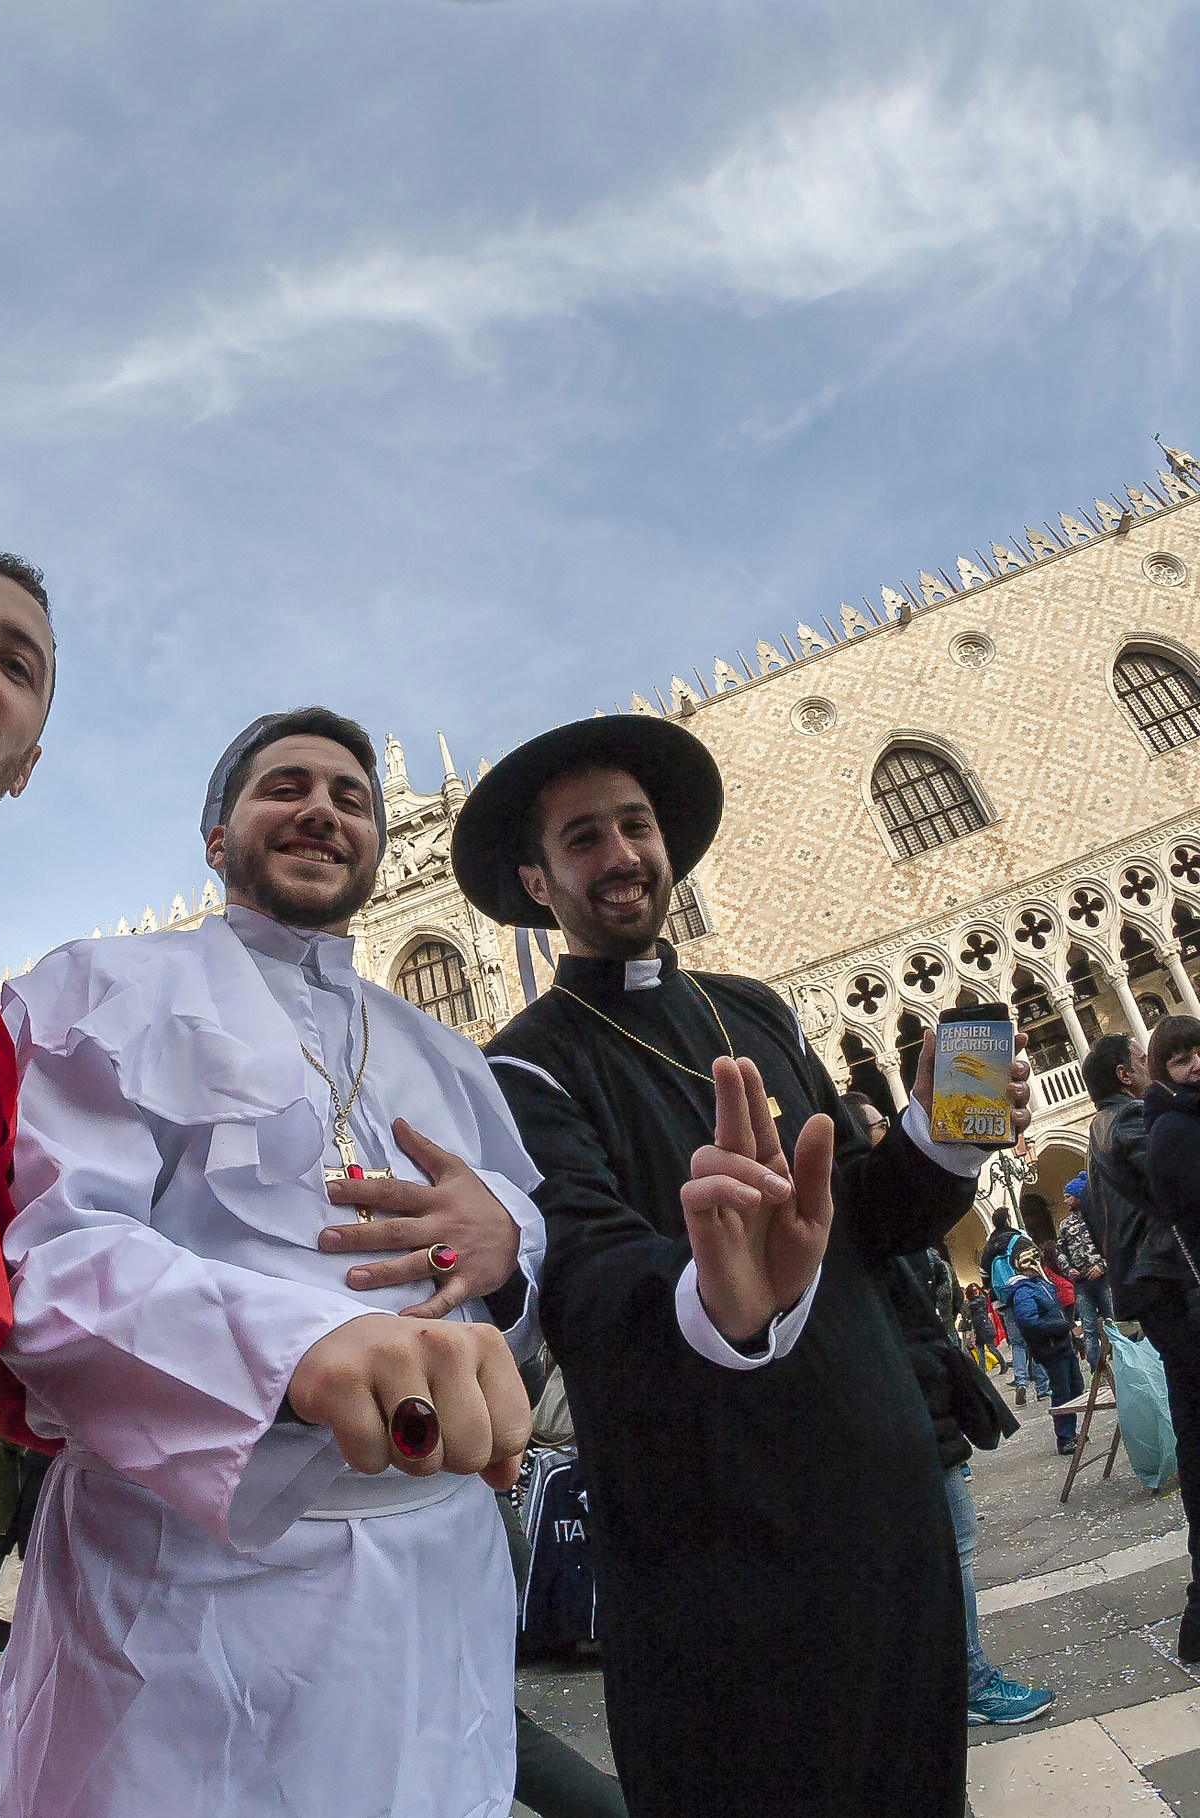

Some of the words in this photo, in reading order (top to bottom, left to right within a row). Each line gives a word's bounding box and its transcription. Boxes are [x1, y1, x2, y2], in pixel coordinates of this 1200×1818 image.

[940, 1026, 991, 1040] PENSIERI
[940, 1039, 1010, 1053] EUCARISTICI
[962, 1115, 1006, 1136] 2013
[554, 1519, 586, 1542] ITA
